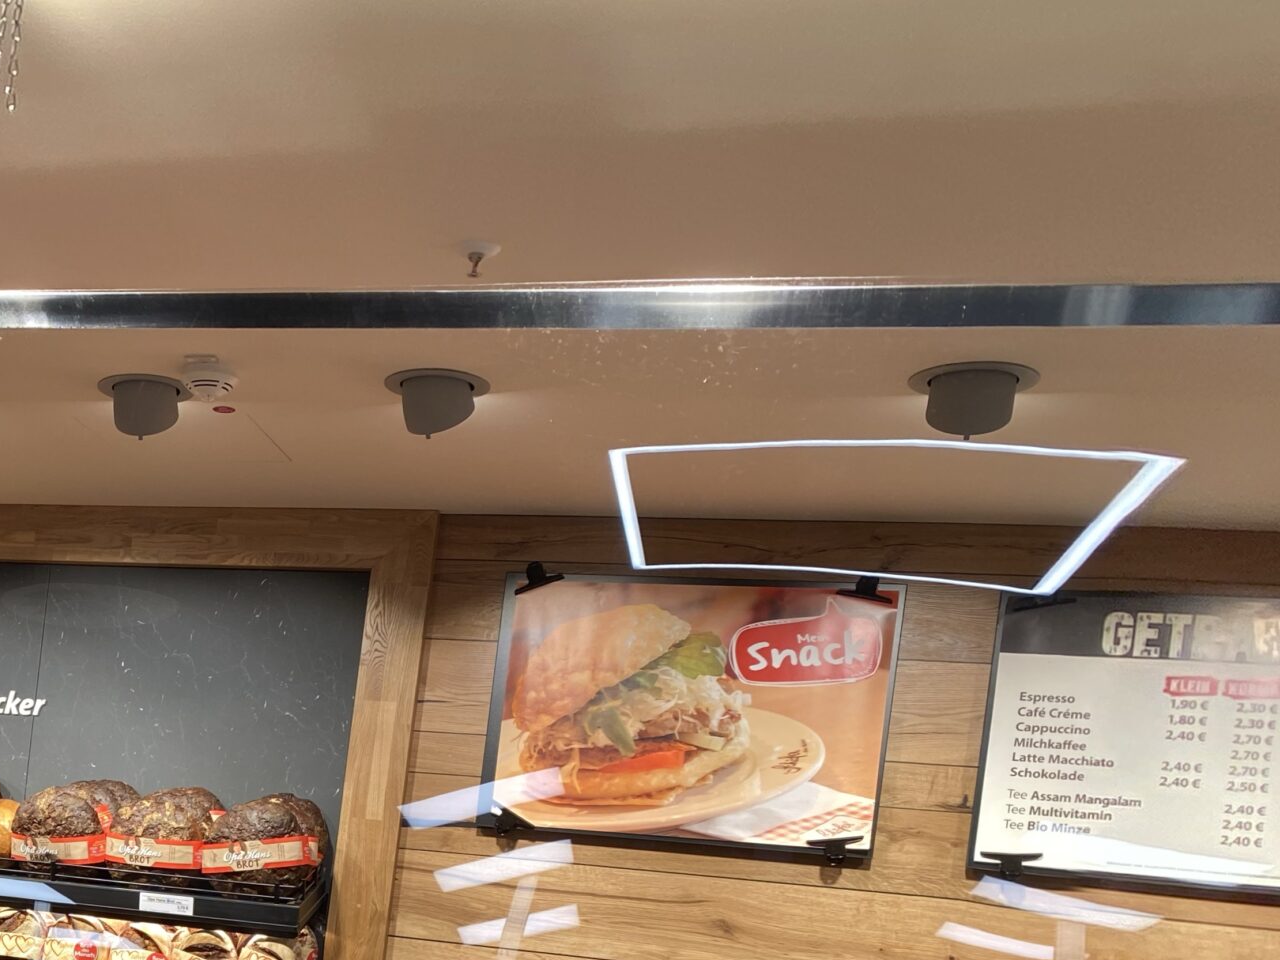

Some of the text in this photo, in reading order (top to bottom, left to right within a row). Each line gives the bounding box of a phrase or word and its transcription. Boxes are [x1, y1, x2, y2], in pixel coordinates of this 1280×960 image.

[747, 629, 866, 672] Snack
[1019, 691, 1076, 705] Espresso
[1170, 699, 1198, 711] 1,90
[1200, 700, 1210, 711] €
[1017, 706, 1277, 730] Café Créme 1,80 € 2,30 €
[1015, 721, 1275, 746] Cappuccino 2,40 € 2,70 €
[1013, 737, 1272, 762] Milchkaffee 2,70 €
[1012, 752, 1271, 778] Latte Macchiato 2,40 € 2,70 €
[1009, 767, 1270, 794] Schokolade 2,40 € 2,50 €
[1007, 788, 1267, 817] Tee Assam Mangalam 2,40 €
[1005, 803, 1265, 832] Tee Multivitamin 2,40 €
[1003, 819, 1264, 848] Tee Bio Minze 2,40 €
[128, 855, 150, 865] BROT
[236, 860, 260, 869] BROT
